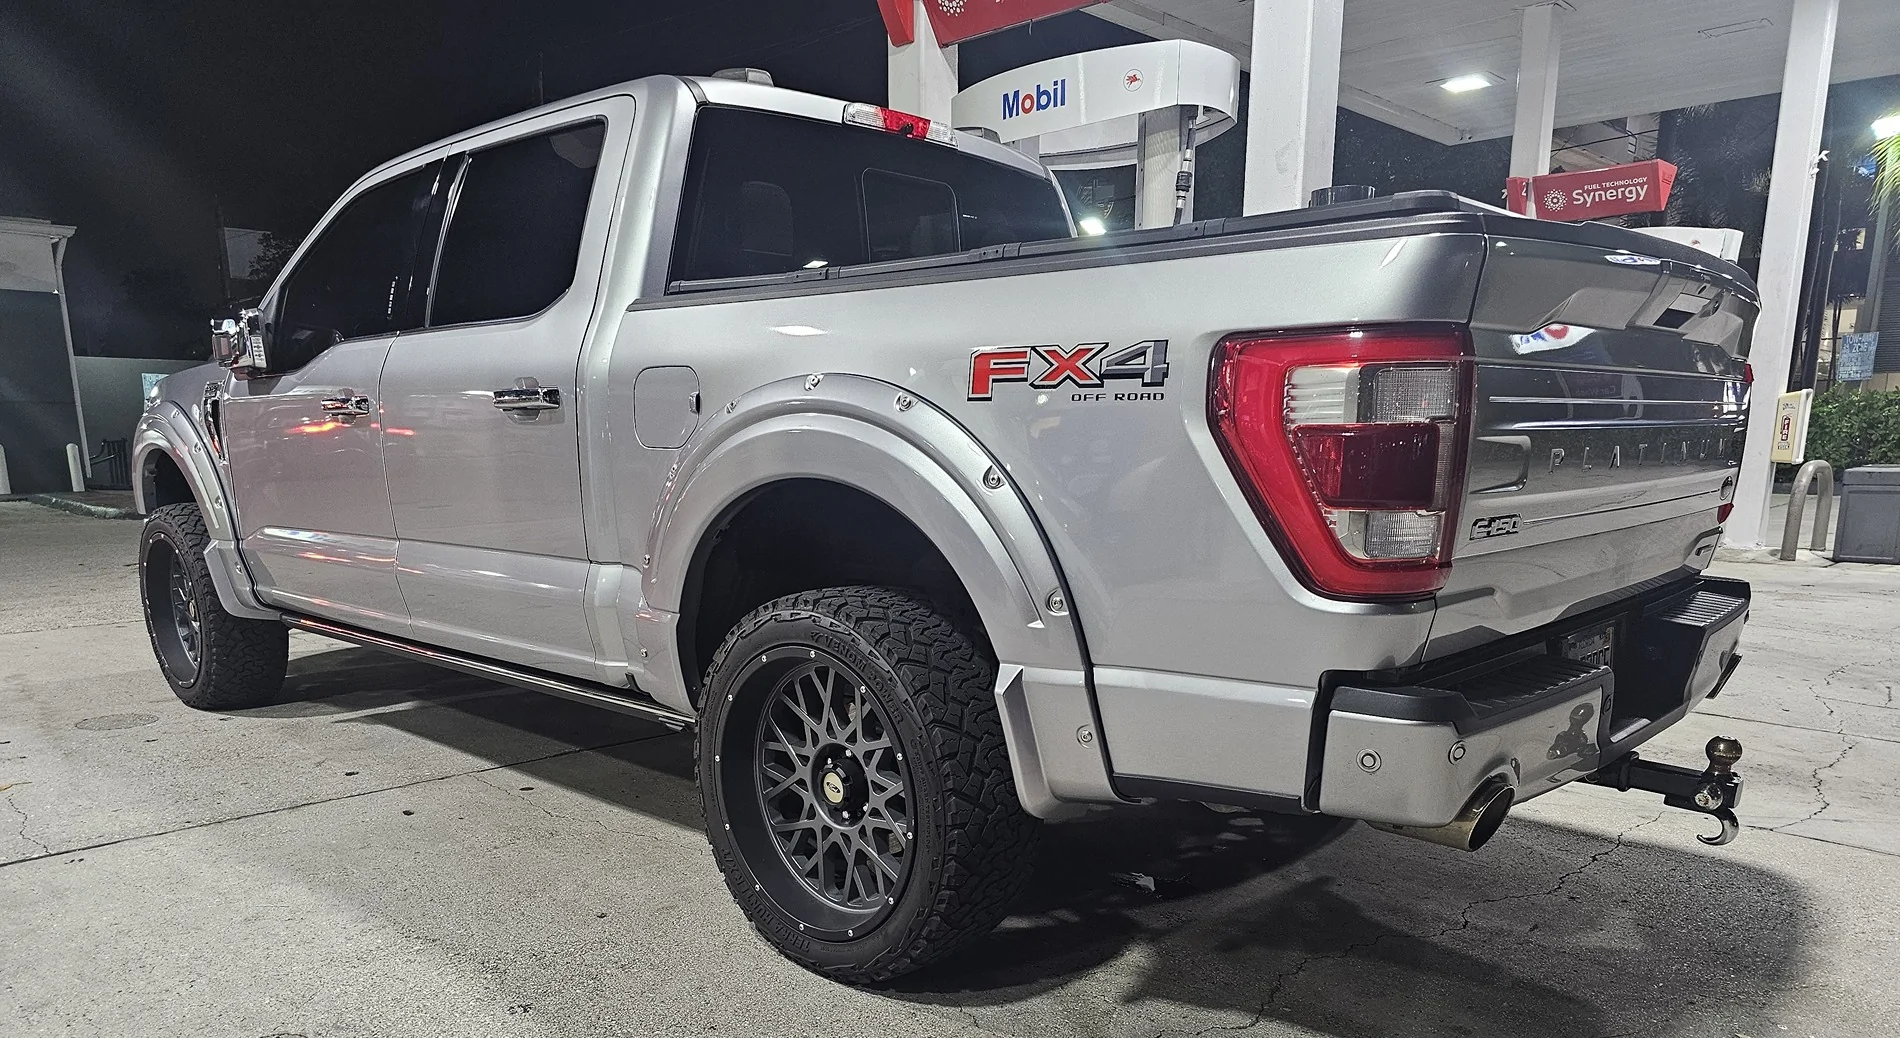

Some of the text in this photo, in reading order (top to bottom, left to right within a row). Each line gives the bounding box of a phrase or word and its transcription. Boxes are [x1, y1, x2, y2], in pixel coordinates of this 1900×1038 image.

[1002, 79, 1066, 120] Mobil
[1602, 176, 1648, 188] TECHNOLOGY
[1572, 184, 1649, 207] Synergy
[967, 340, 1170, 402] FX4
[1071, 392, 1165, 402] OFF ROAD
[1781, 419, 1790, 440] FIRE
[1549, 438, 1727, 474] PLATINUM
